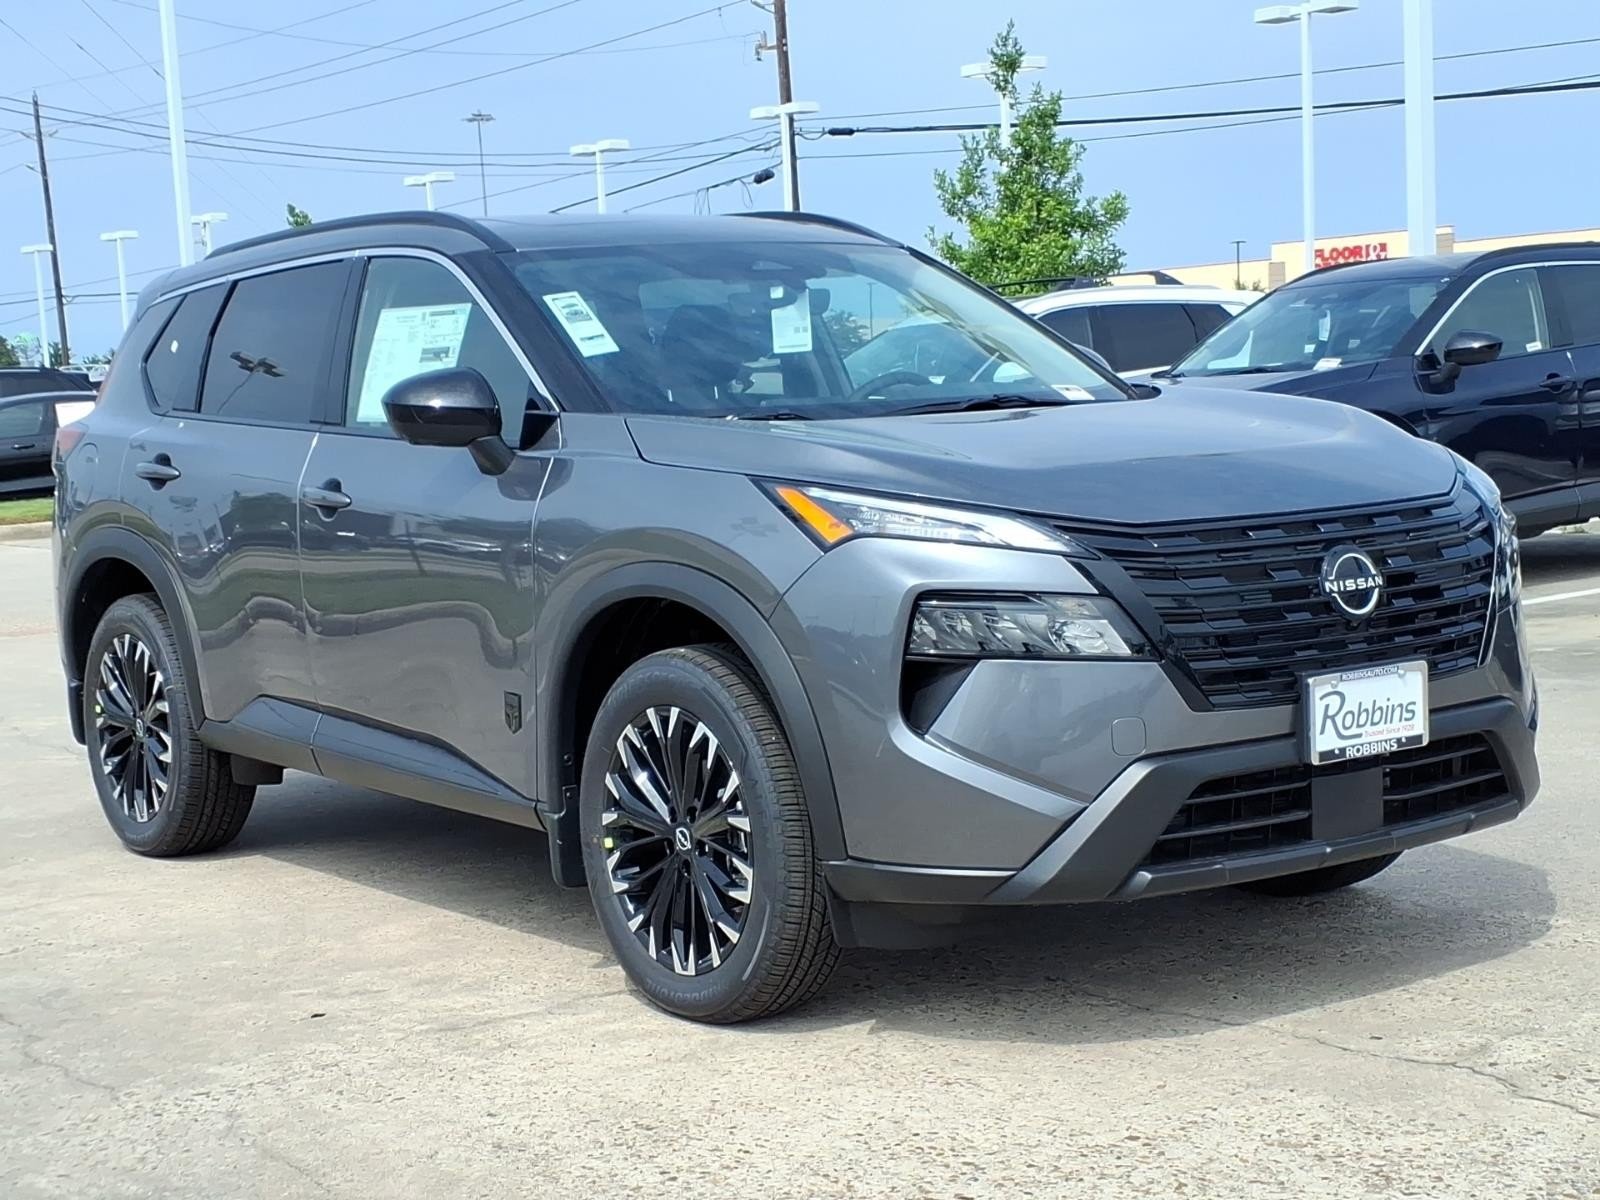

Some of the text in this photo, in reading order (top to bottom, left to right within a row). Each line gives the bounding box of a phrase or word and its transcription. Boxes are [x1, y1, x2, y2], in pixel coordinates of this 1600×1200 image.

[1314, 245, 1362, 262] FLOOR
[1324, 576, 1383, 592] NISSAN
[1319, 690, 1416, 741] Robbins
[1346, 739, 1398, 758] ROBBINS
